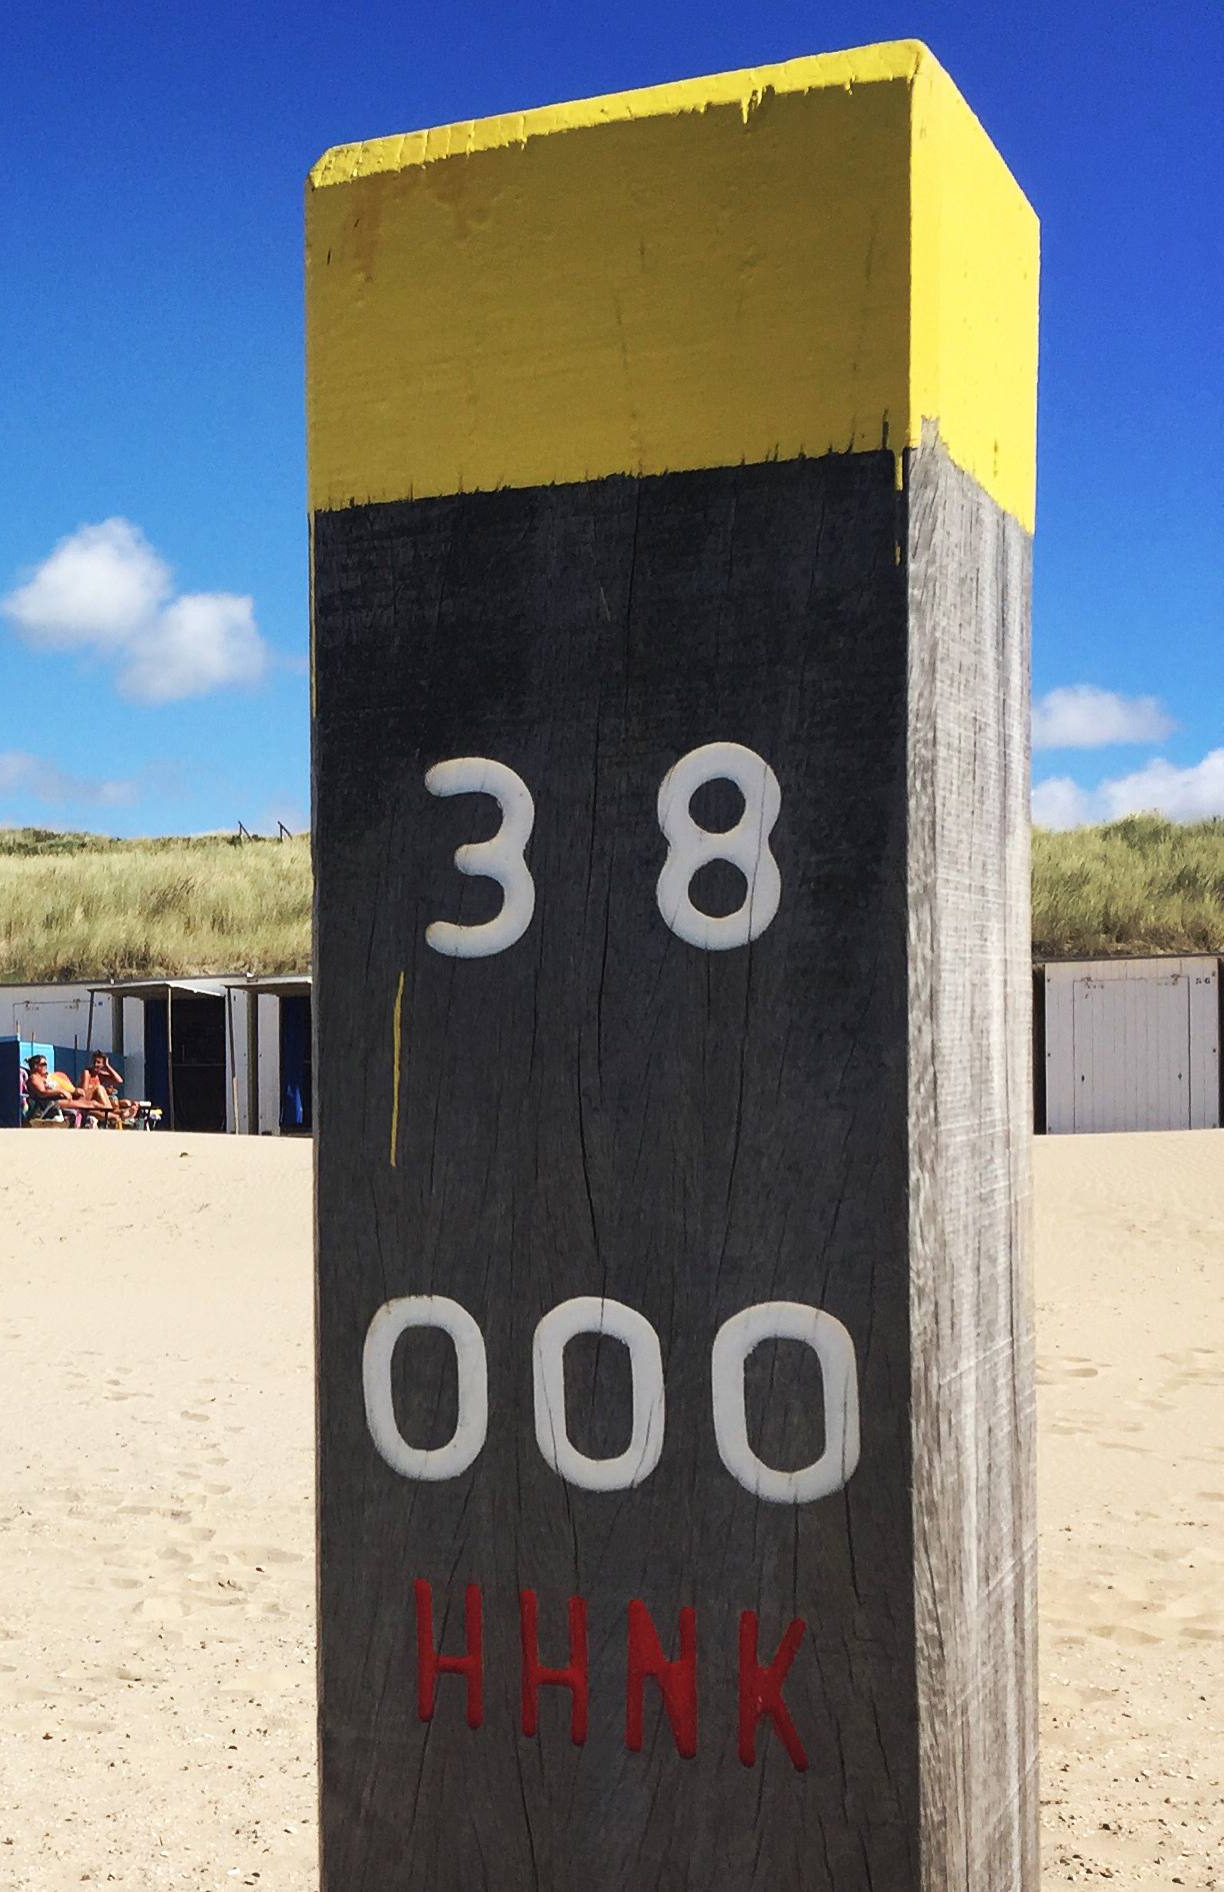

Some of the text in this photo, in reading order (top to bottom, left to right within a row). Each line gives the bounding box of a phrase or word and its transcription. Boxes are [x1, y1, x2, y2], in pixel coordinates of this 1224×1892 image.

[425, 741, 782, 958] 38
[362, 1295, 860, 1503] 000
[415, 1579, 808, 1773] HHNK
